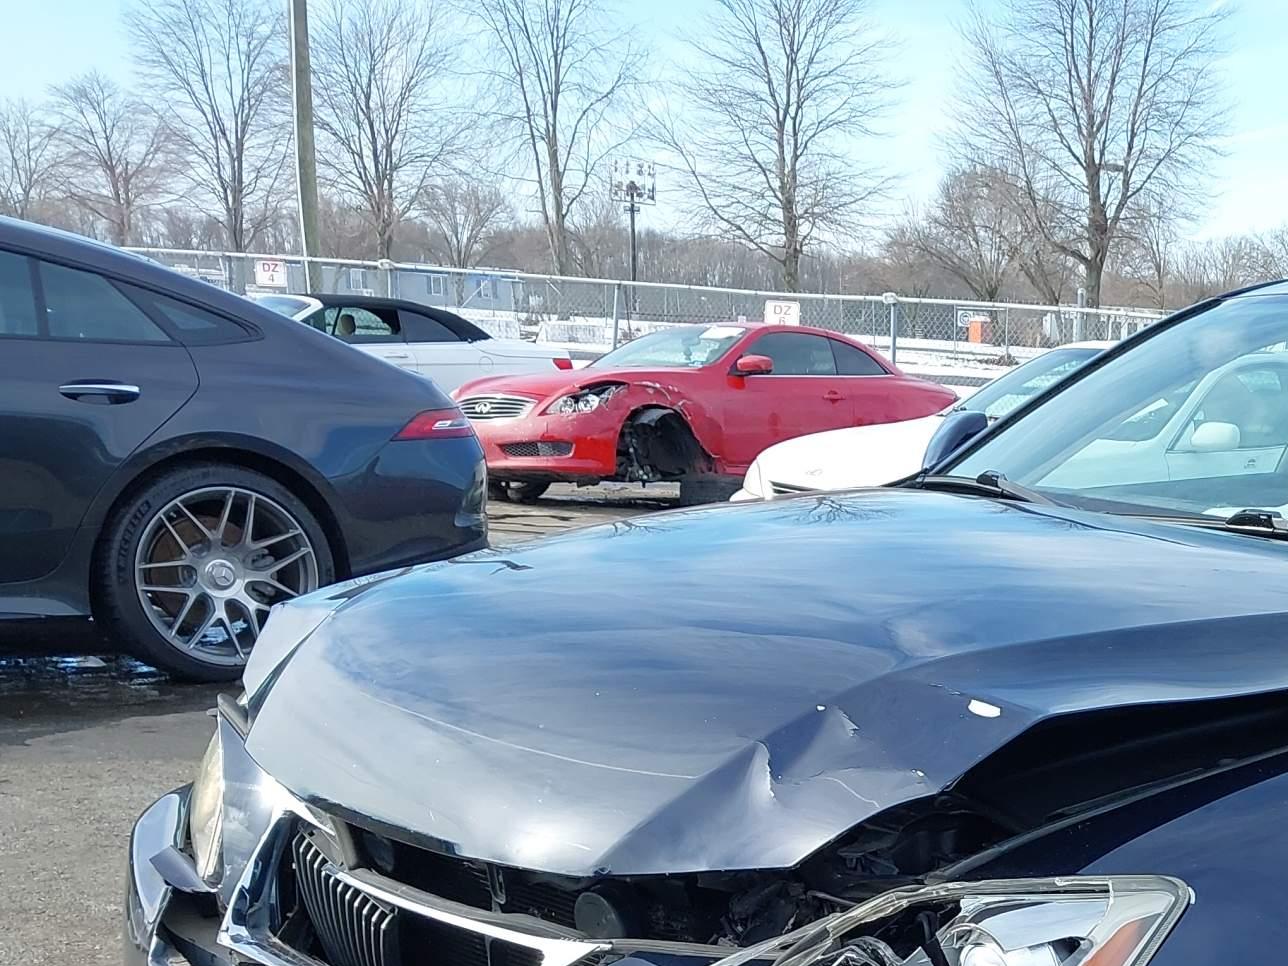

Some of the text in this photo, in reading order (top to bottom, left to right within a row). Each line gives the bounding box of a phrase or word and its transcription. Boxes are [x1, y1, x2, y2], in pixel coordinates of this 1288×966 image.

[262, 262, 279, 273] DZ
[268, 273, 275, 282] 4
[774, 304, 792, 316] DZ
